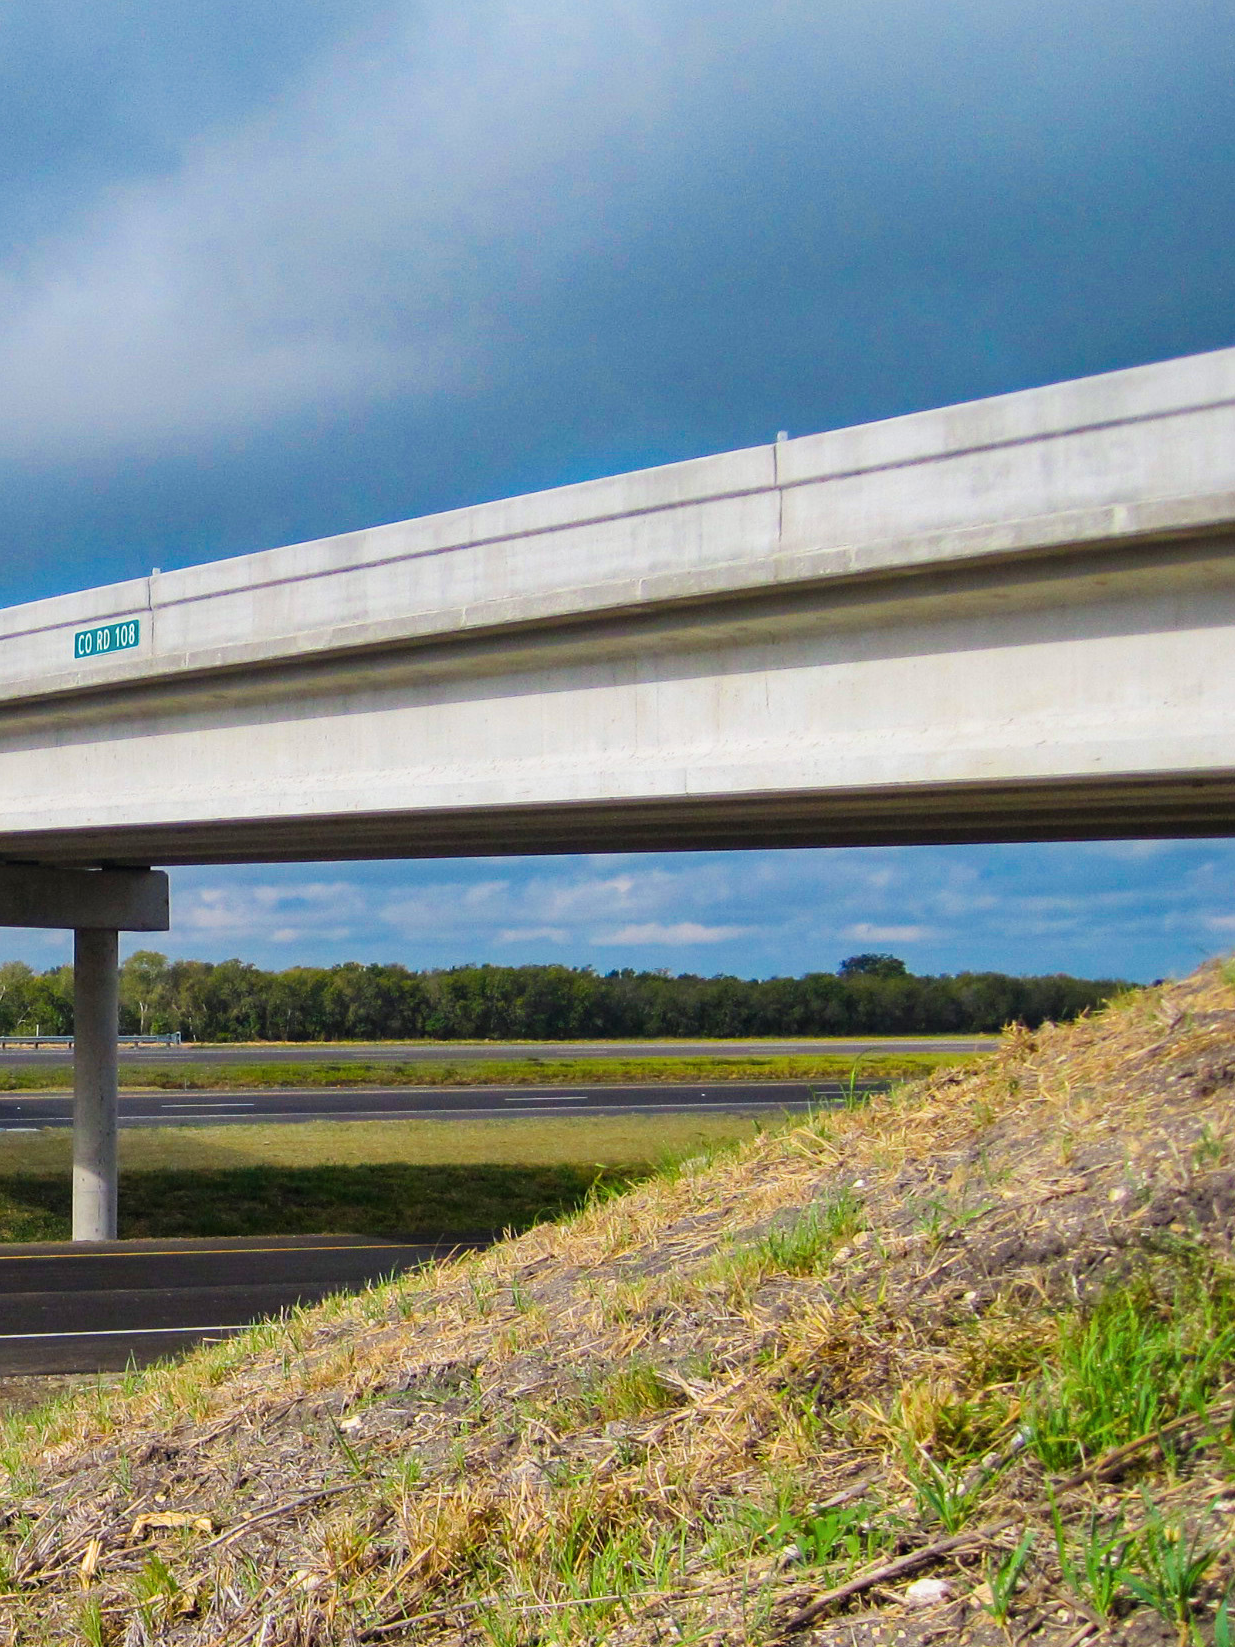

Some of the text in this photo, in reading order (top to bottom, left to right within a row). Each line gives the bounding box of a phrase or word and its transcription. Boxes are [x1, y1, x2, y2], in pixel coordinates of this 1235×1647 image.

[78, 623, 135, 655] CO RD 108
